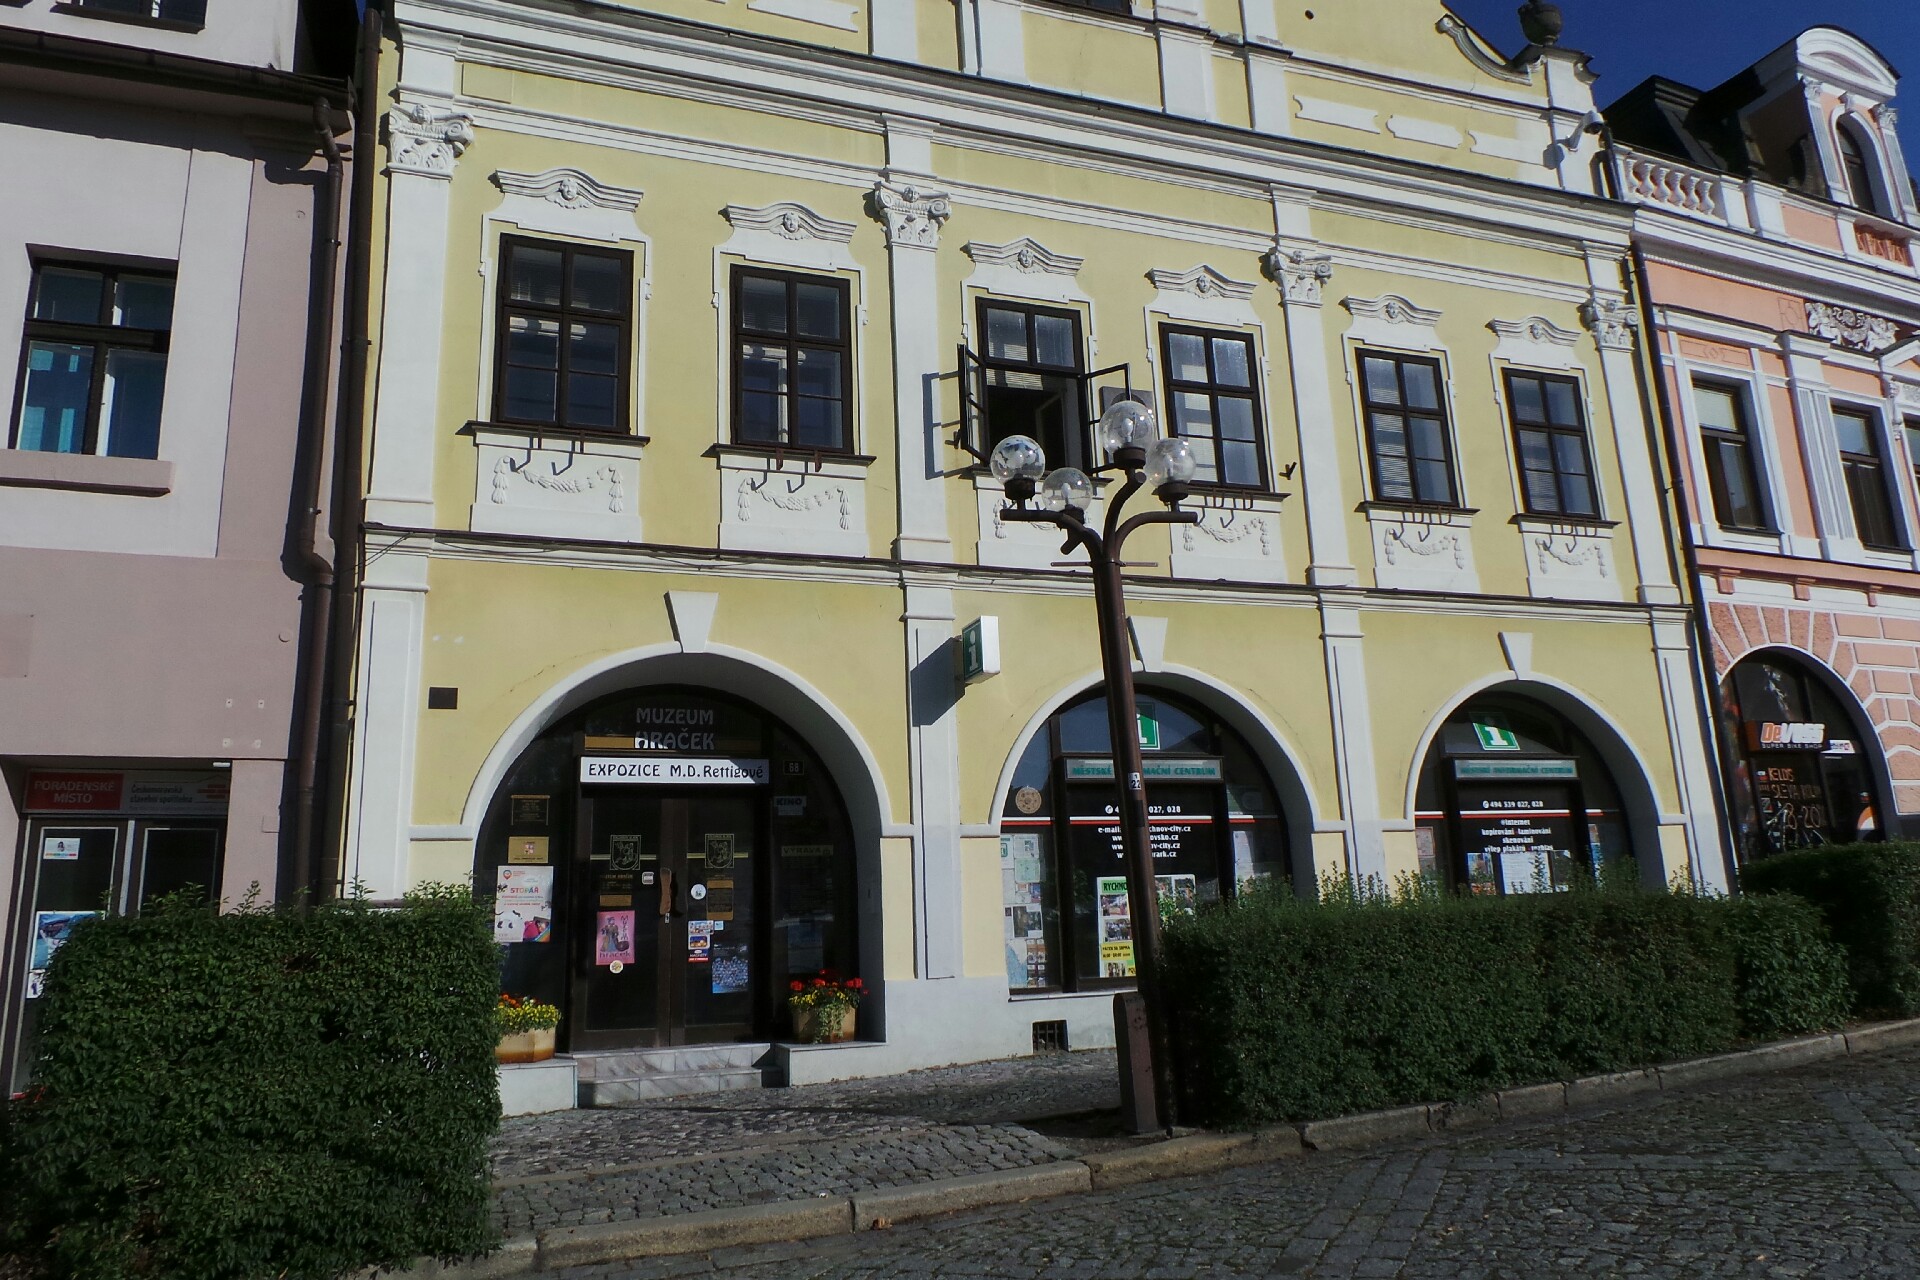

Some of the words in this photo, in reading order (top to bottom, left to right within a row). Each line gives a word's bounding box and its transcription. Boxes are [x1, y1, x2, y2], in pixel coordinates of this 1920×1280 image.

[635, 708, 714, 725] MUZEUM
[635, 727, 715, 750] HRAČEK
[588, 763, 661, 777] EXPOZICE
[703, 765, 764, 780] Rettigové
[1174, 767, 1217, 776] CENTRUM
[33, 779, 117, 793] PORADENSKÉ
[53, 792, 94, 804] MÍSTO
[1103, 882, 1128, 891] RYCHNO
